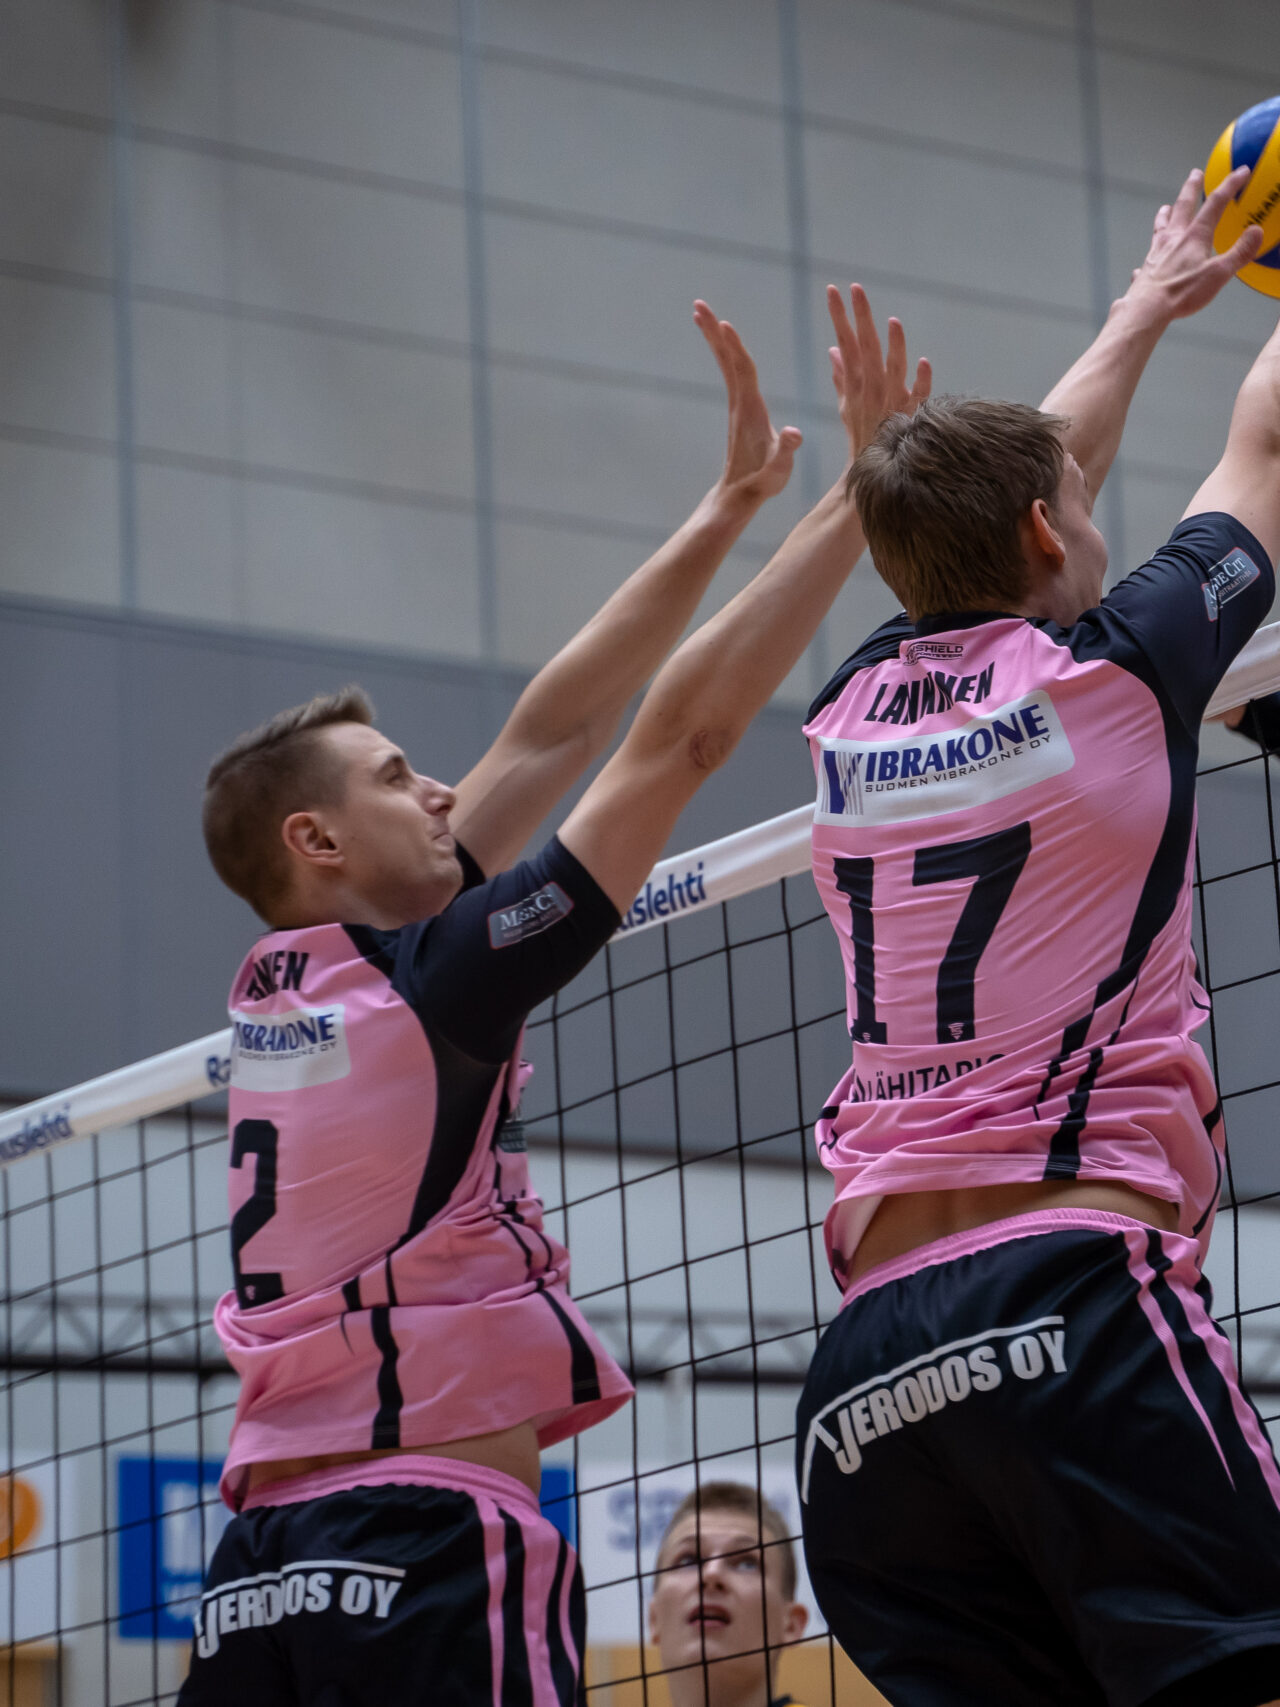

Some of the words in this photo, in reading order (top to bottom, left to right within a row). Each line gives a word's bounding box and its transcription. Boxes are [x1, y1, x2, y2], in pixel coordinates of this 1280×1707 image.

[865, 777, 928, 793] SUOMEN
[933, 747, 1023, 783] VIBRAKONE
[1030, 734, 1051, 749] OY
[833, 821, 1031, 1044] 17
[230, 1119, 286, 1310] 2
[834, 1346, 1003, 1475] JERODOS
[1008, 1331, 1068, 1380] OY
[340, 1574, 403, 1618] OY
